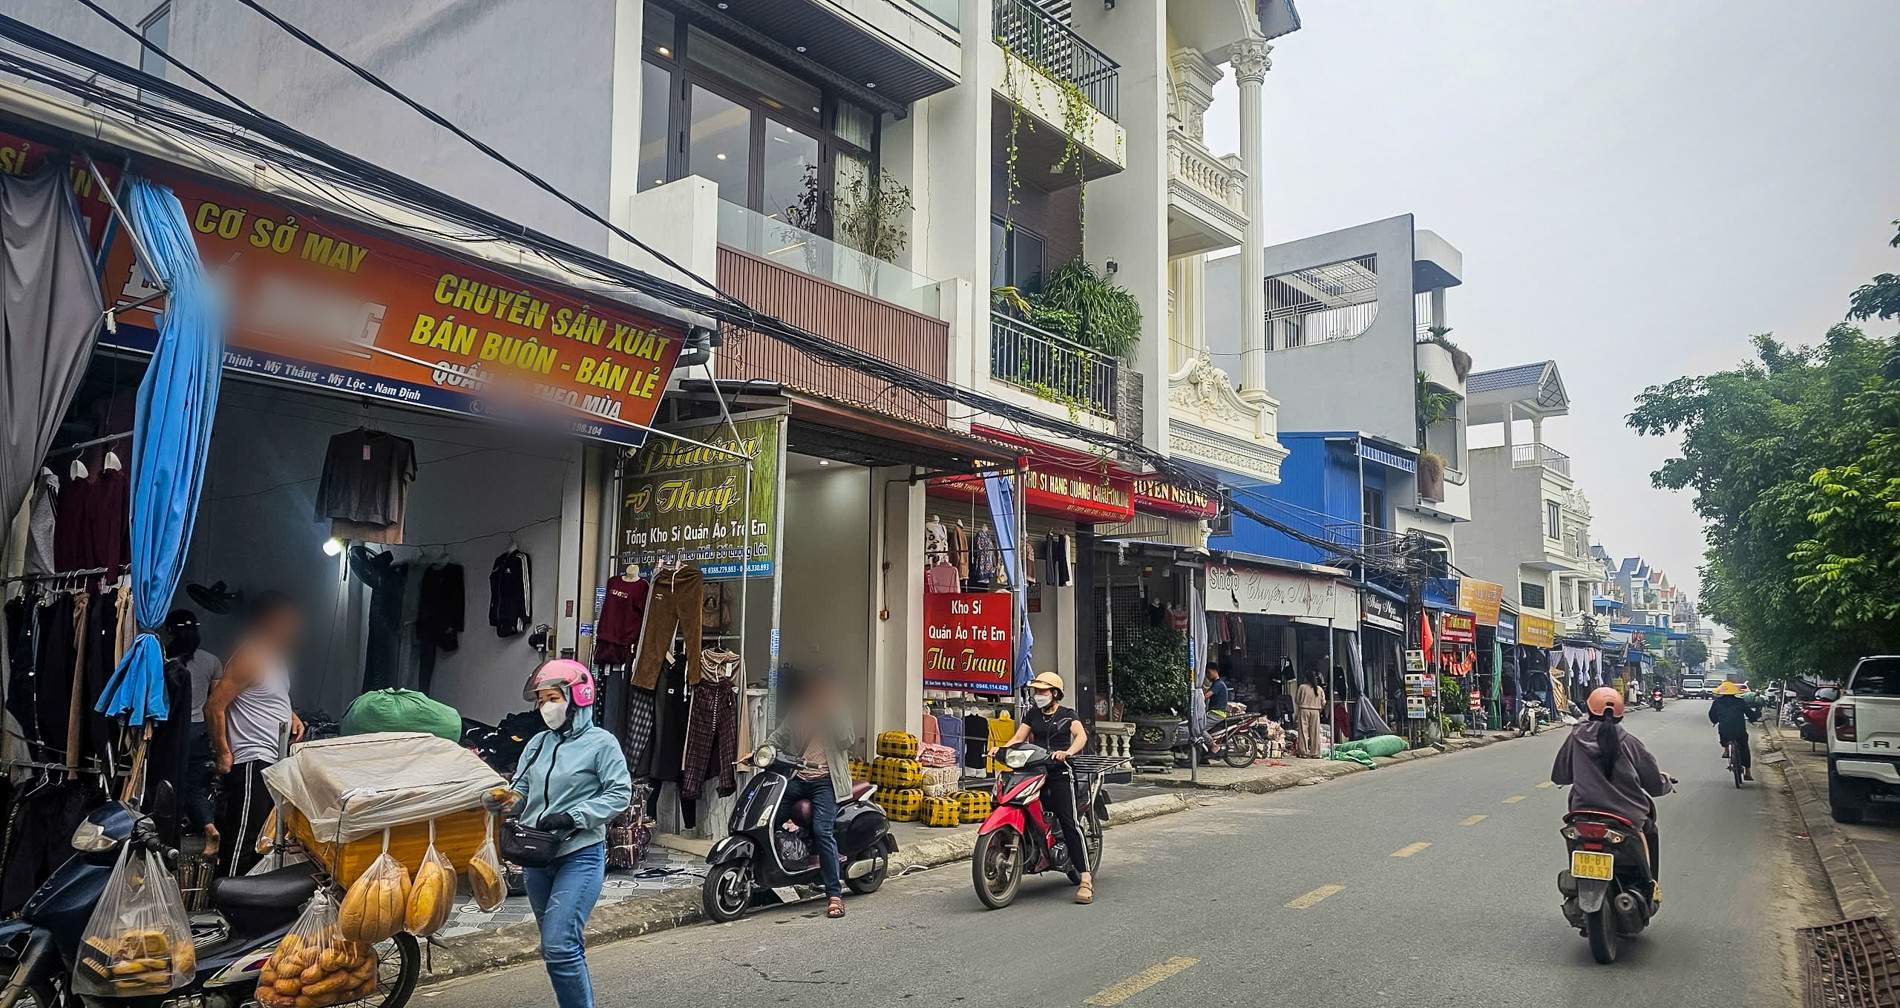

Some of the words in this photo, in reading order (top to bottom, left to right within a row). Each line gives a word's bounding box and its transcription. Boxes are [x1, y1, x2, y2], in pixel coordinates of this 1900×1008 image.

[194, 202, 248, 240] CƠ
[249, 215, 301, 253] SỞ
[300, 233, 370, 273] MAY
[434, 273, 550, 330] CHUYÊN
[551, 304, 608, 346] SẢN
[606, 324, 670, 362] XUẤT
[409, 314, 478, 356] BÁN
[479, 331, 557, 374] BUÔN
[560, 362, 571, 371] -
[574, 355, 629, 392] BÁN
[629, 366, 660, 399] LẺ
[264, 359, 282, 375] Mỹ
[284, 364, 319, 382] Thắng
[327, 373, 345, 388] Mỹ
[346, 376, 366, 391] Lộc
[374, 382, 396, 396] Nam
[398, 386, 421, 402] Định
[582, 394, 622, 420] MÙA
[626, 528, 647, 547] Tổng
[650, 527, 668, 543] Kho
[684, 522, 708, 540] Quần
[713, 519, 726, 538] Áo
[751, 519, 767, 536] Em
[951, 600, 969, 614] Kho
[929, 624, 951, 639] Quần
[955, 622, 968, 639] Áo
[971, 625, 987, 640] Trẻ
[991, 627, 1005, 640] Em
[927, 647, 955, 670] Thu
[961, 648, 1006, 678] Trang
